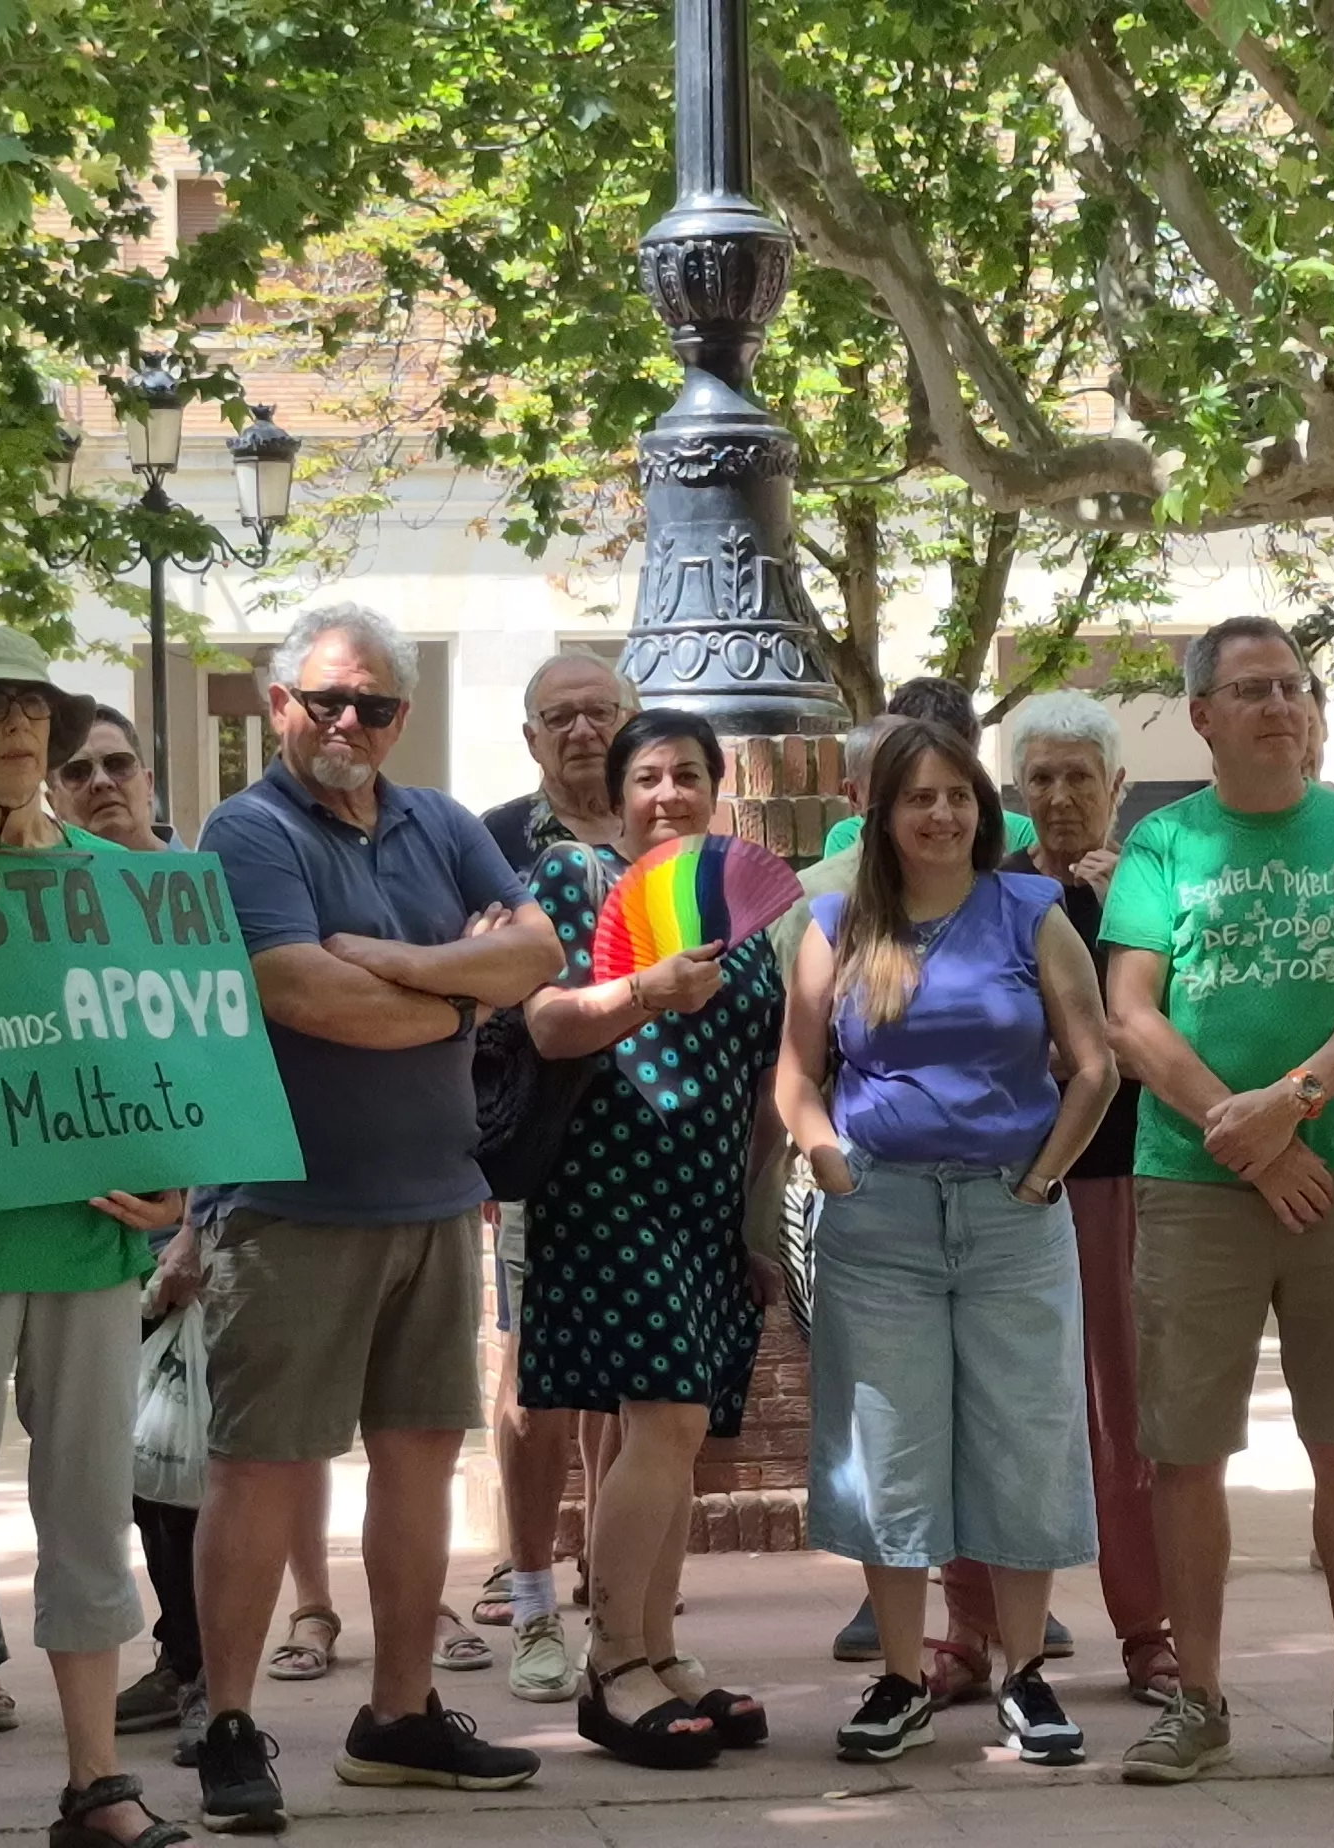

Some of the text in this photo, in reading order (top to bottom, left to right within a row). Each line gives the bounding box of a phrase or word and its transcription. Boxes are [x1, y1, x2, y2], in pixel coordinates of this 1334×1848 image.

[119, 868, 232, 947] YA!
[1177, 864, 1274, 908] ESCUELA
[1202, 922, 1240, 951] DE
[63, 966, 250, 1042] APOYO
[0, 1061, 205, 1148] Maltrato
